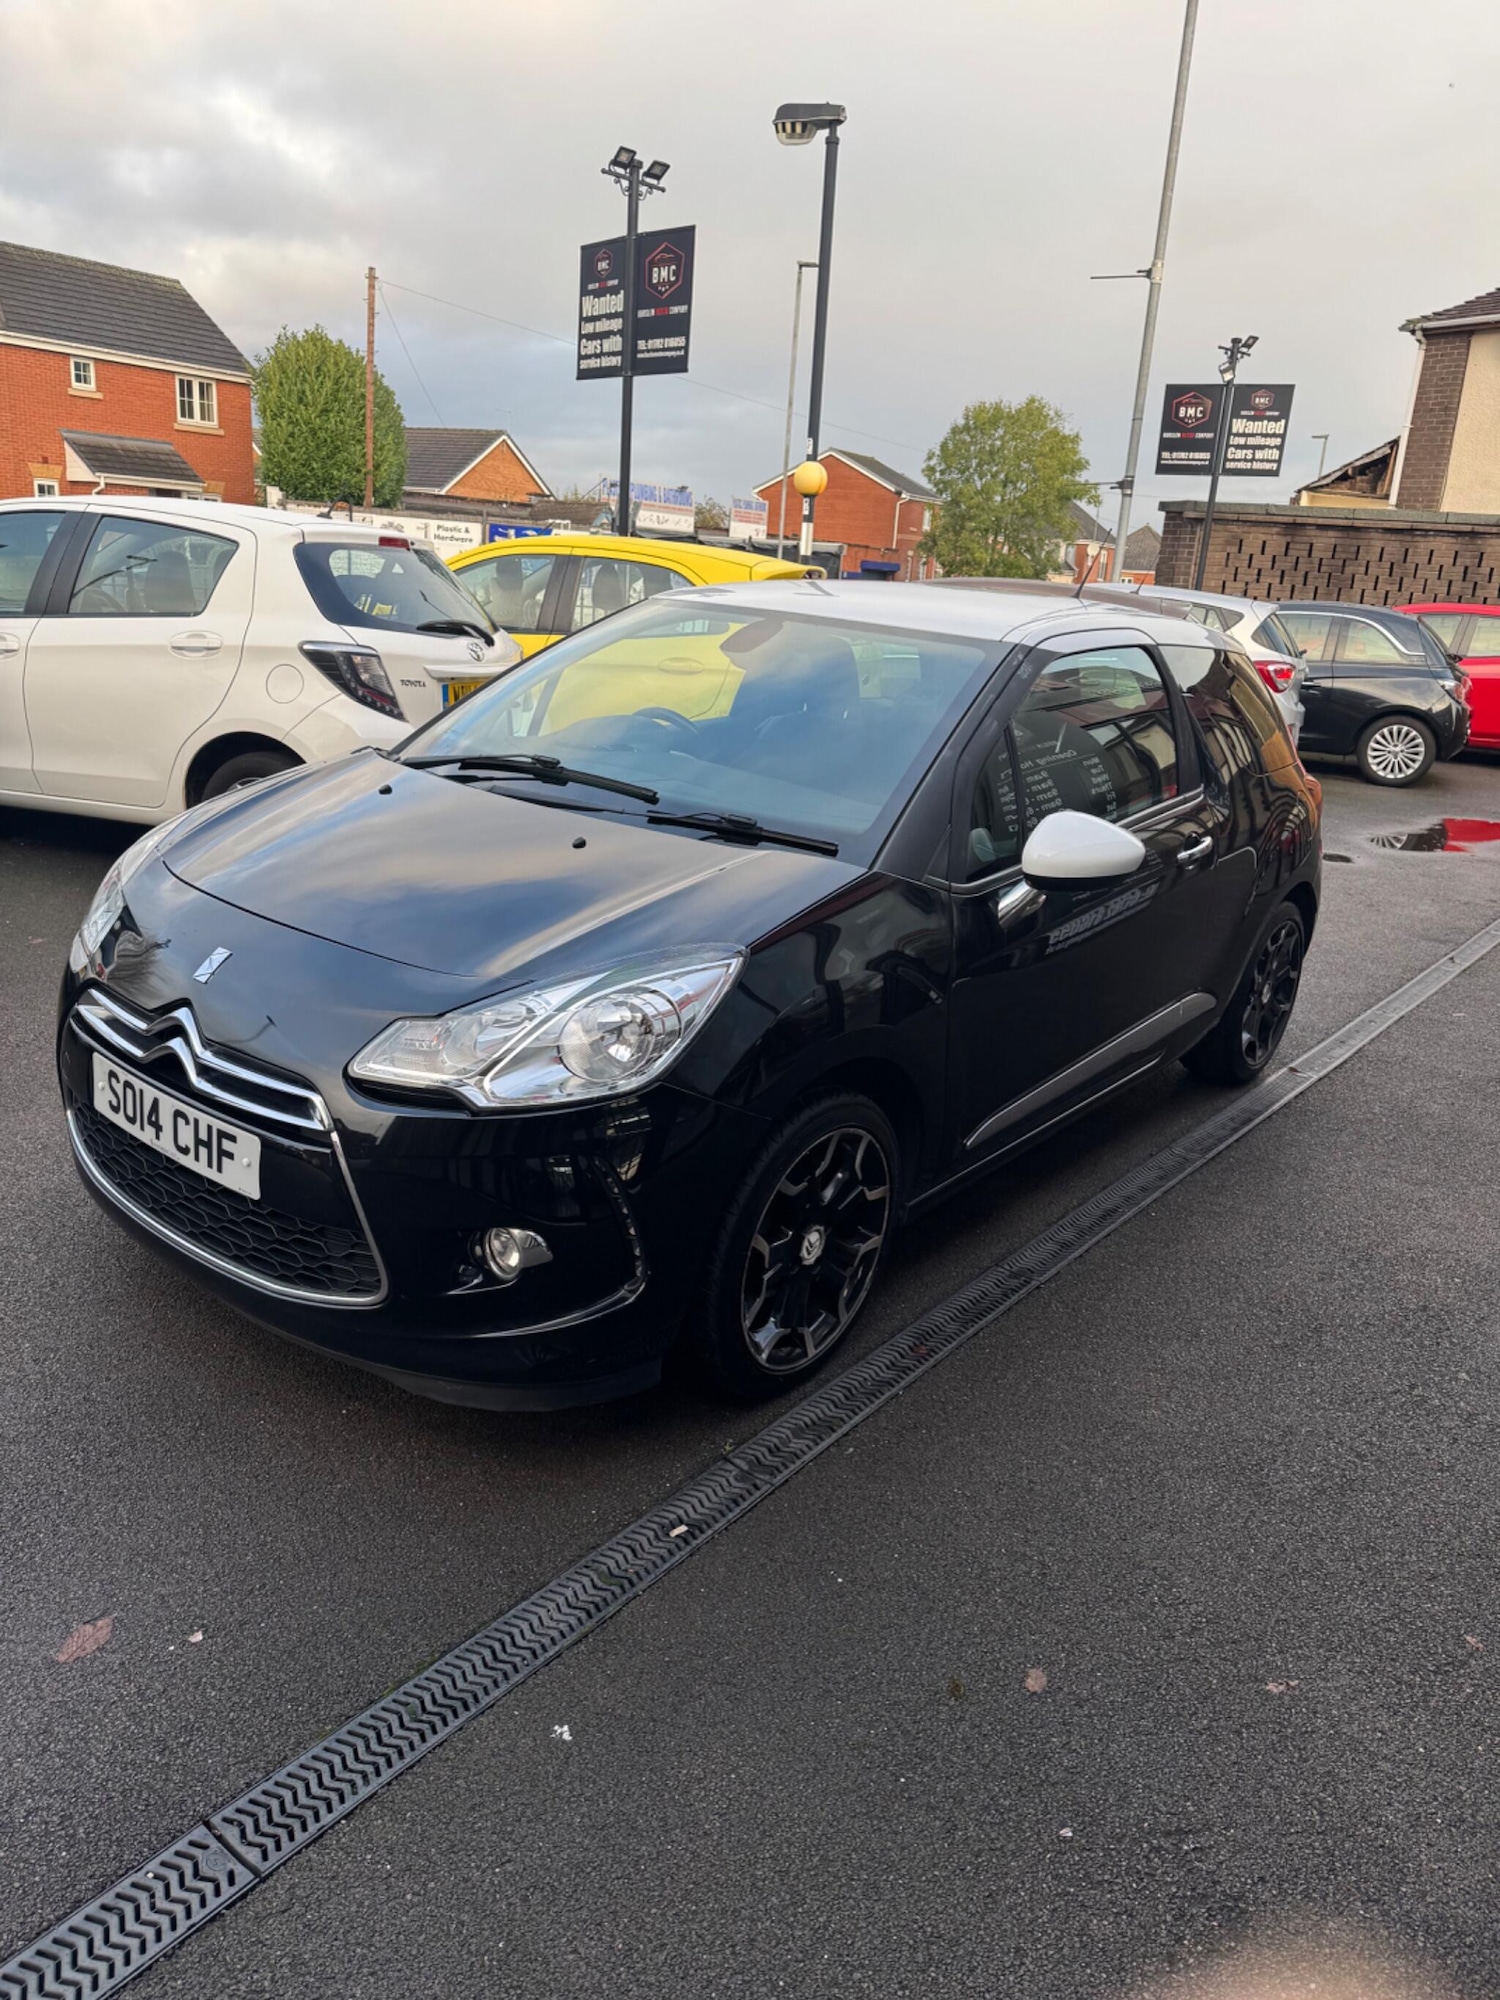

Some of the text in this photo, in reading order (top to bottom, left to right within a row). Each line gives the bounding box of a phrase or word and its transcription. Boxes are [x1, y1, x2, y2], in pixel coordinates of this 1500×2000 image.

[597, 260, 610, 271] BMC
[652, 265, 677, 284] BMC
[582, 290, 624, 317] Wanted
[581, 317, 623, 334] Low mileage
[580, 334, 623, 355] Cars with
[580, 354, 622, 369] service history
[1255, 397, 1269, 405] BMC
[1178, 406, 1204, 418] BMC
[1231, 418, 1286, 434] Wanted
[1229, 436, 1282, 447] Low mileage
[1227, 446, 1280, 460] Cars with
[1225, 460, 1278, 471] service history
[436, 524, 471, 534] Plastic &
[433, 534, 473, 544] Hardware
[400, 679, 426, 688] TOYOTA
[107, 1069, 238, 1174] SO14 CHF
